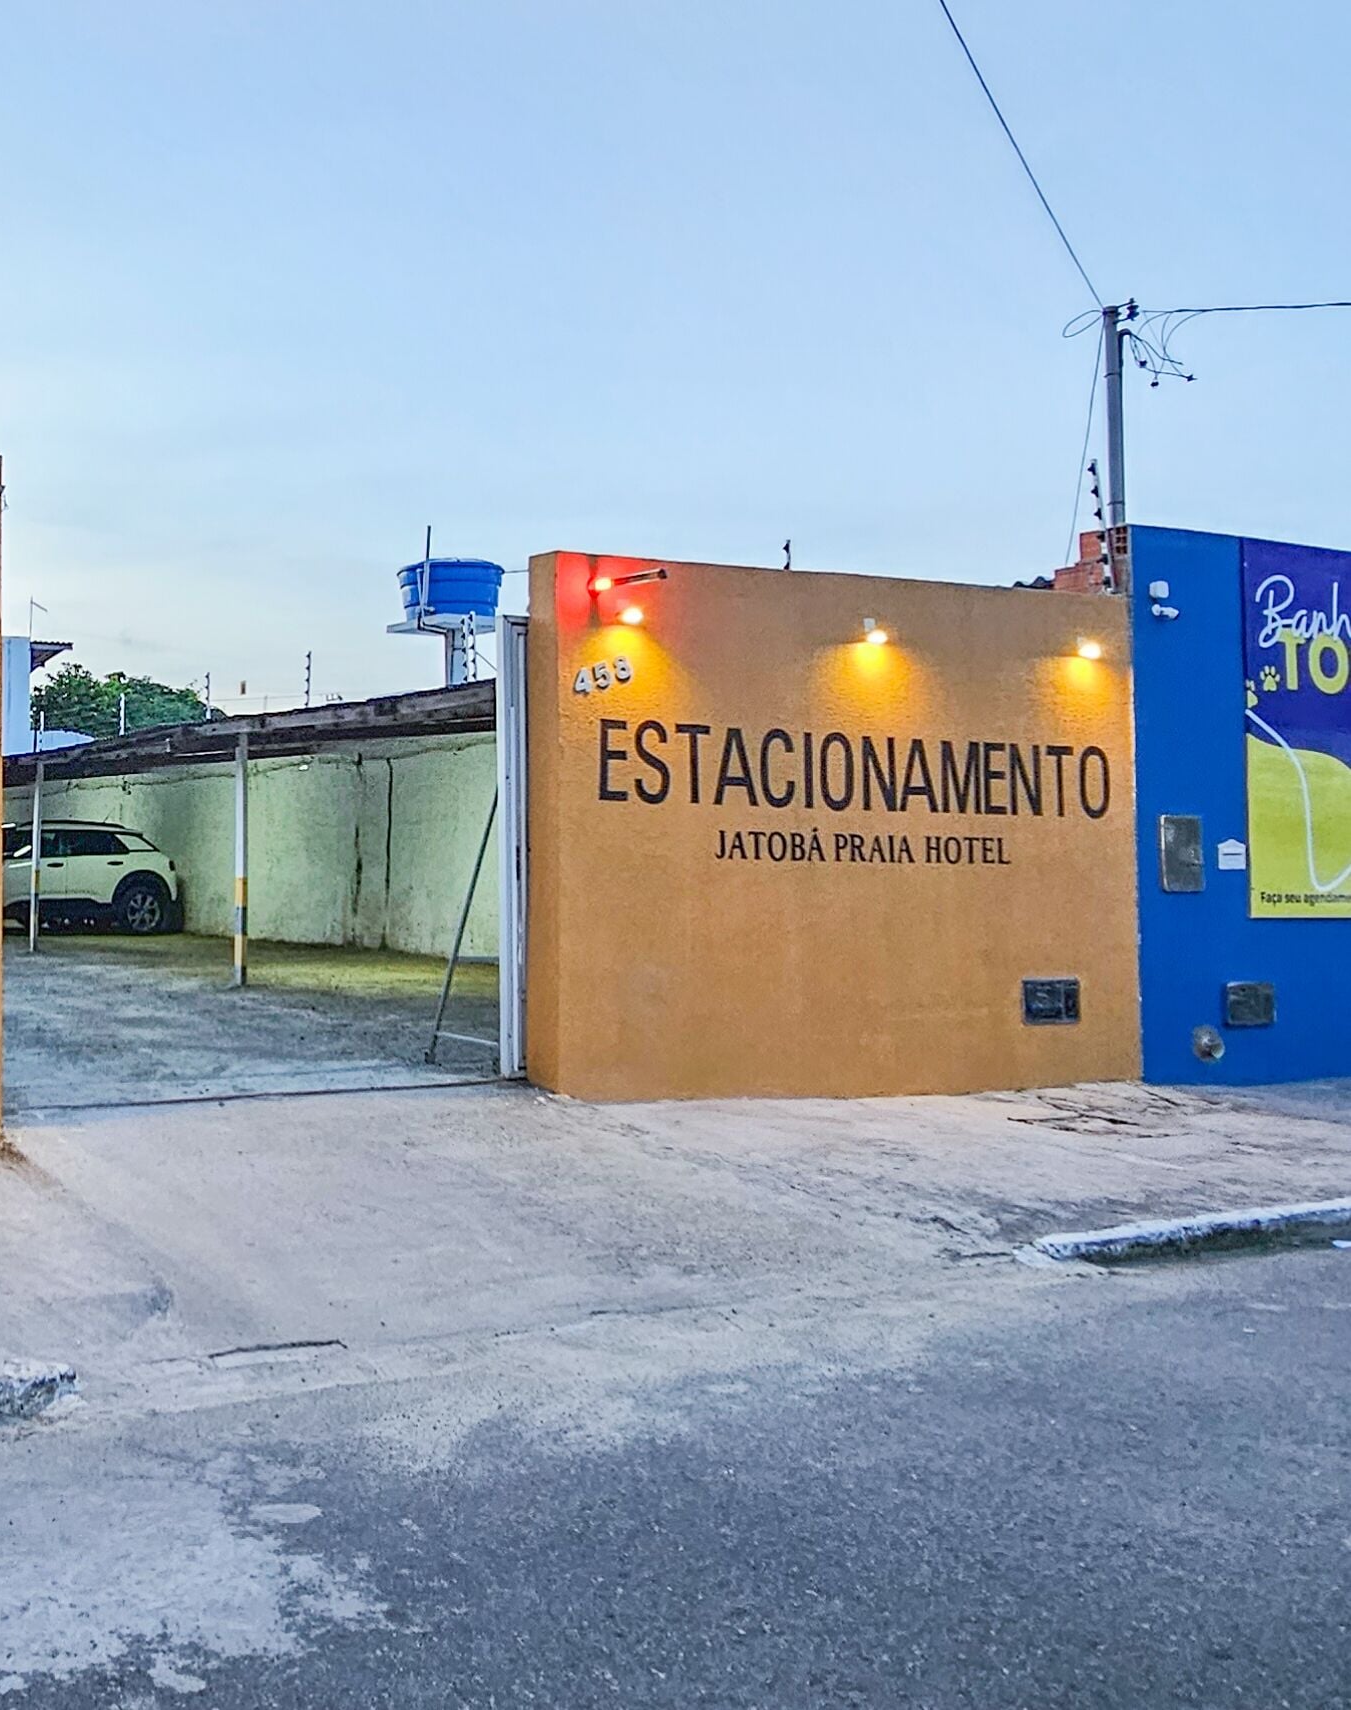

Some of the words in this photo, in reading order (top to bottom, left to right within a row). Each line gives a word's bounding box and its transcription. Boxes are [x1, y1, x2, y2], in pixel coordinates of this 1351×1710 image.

[573, 656, 631, 696] 458
[598, 718, 1110, 820] ESTACIONAMENTO
[715, 827, 826, 862] JATOBÁ
[833, 833, 916, 864] PRAIA
[925, 836, 1011, 865] HOTEL
[1261, 892, 1282, 907] Faça
